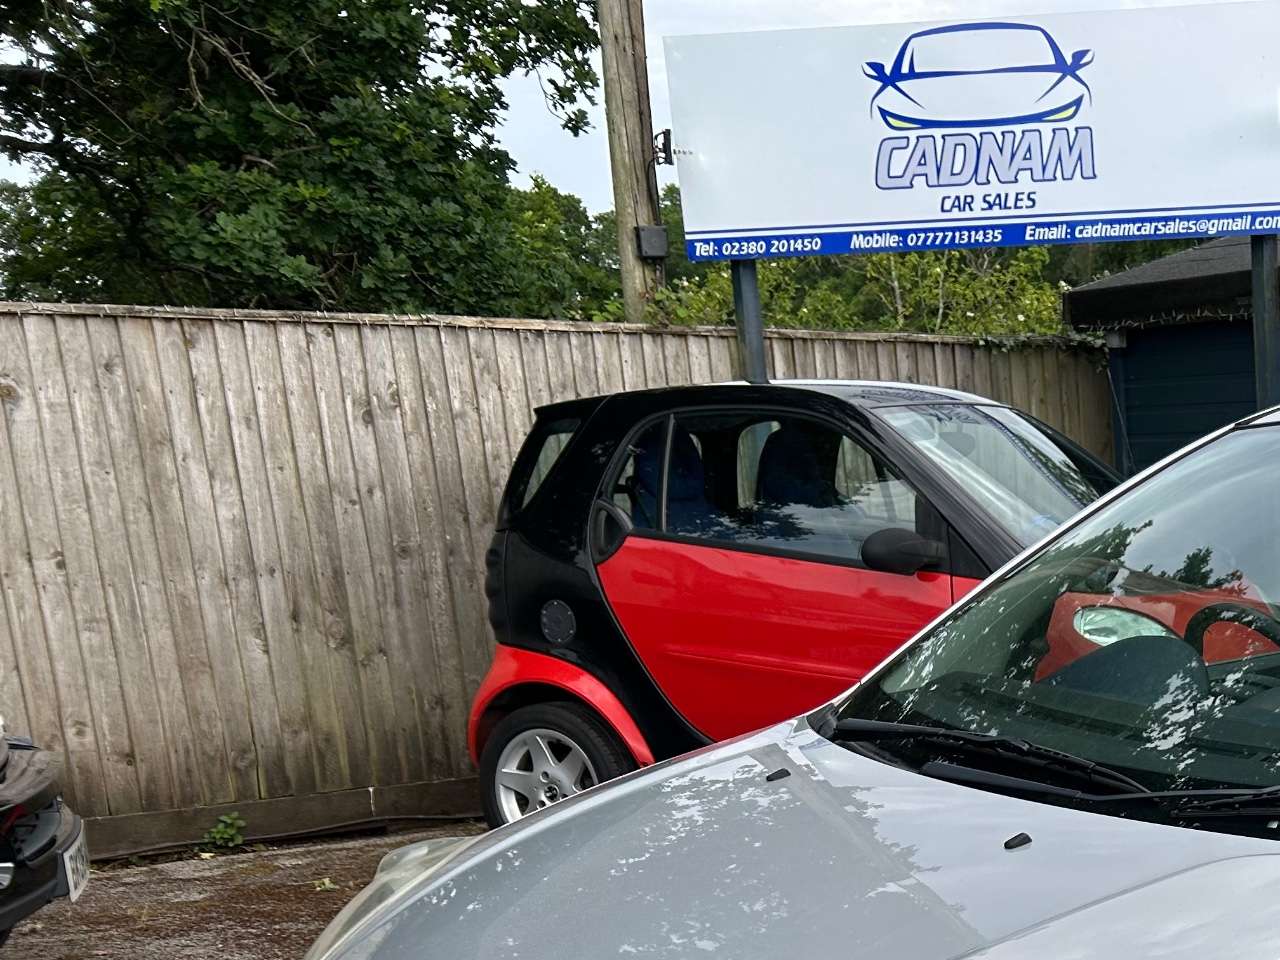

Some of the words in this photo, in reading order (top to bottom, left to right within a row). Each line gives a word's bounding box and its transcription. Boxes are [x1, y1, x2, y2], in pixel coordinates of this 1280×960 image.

[875, 126, 1097, 190] CADNAM
[940, 195, 975, 213] CAR
[981, 191, 1037, 211] SALES
[694, 242, 718, 257] Tel:
[722, 241, 767, 256] 02380
[770, 238, 822, 253] 201450
[850, 233, 903, 249] Mobile:
[907, 228, 1002, 247] 07777131435
[1024, 224, 1071, 241] Email:
